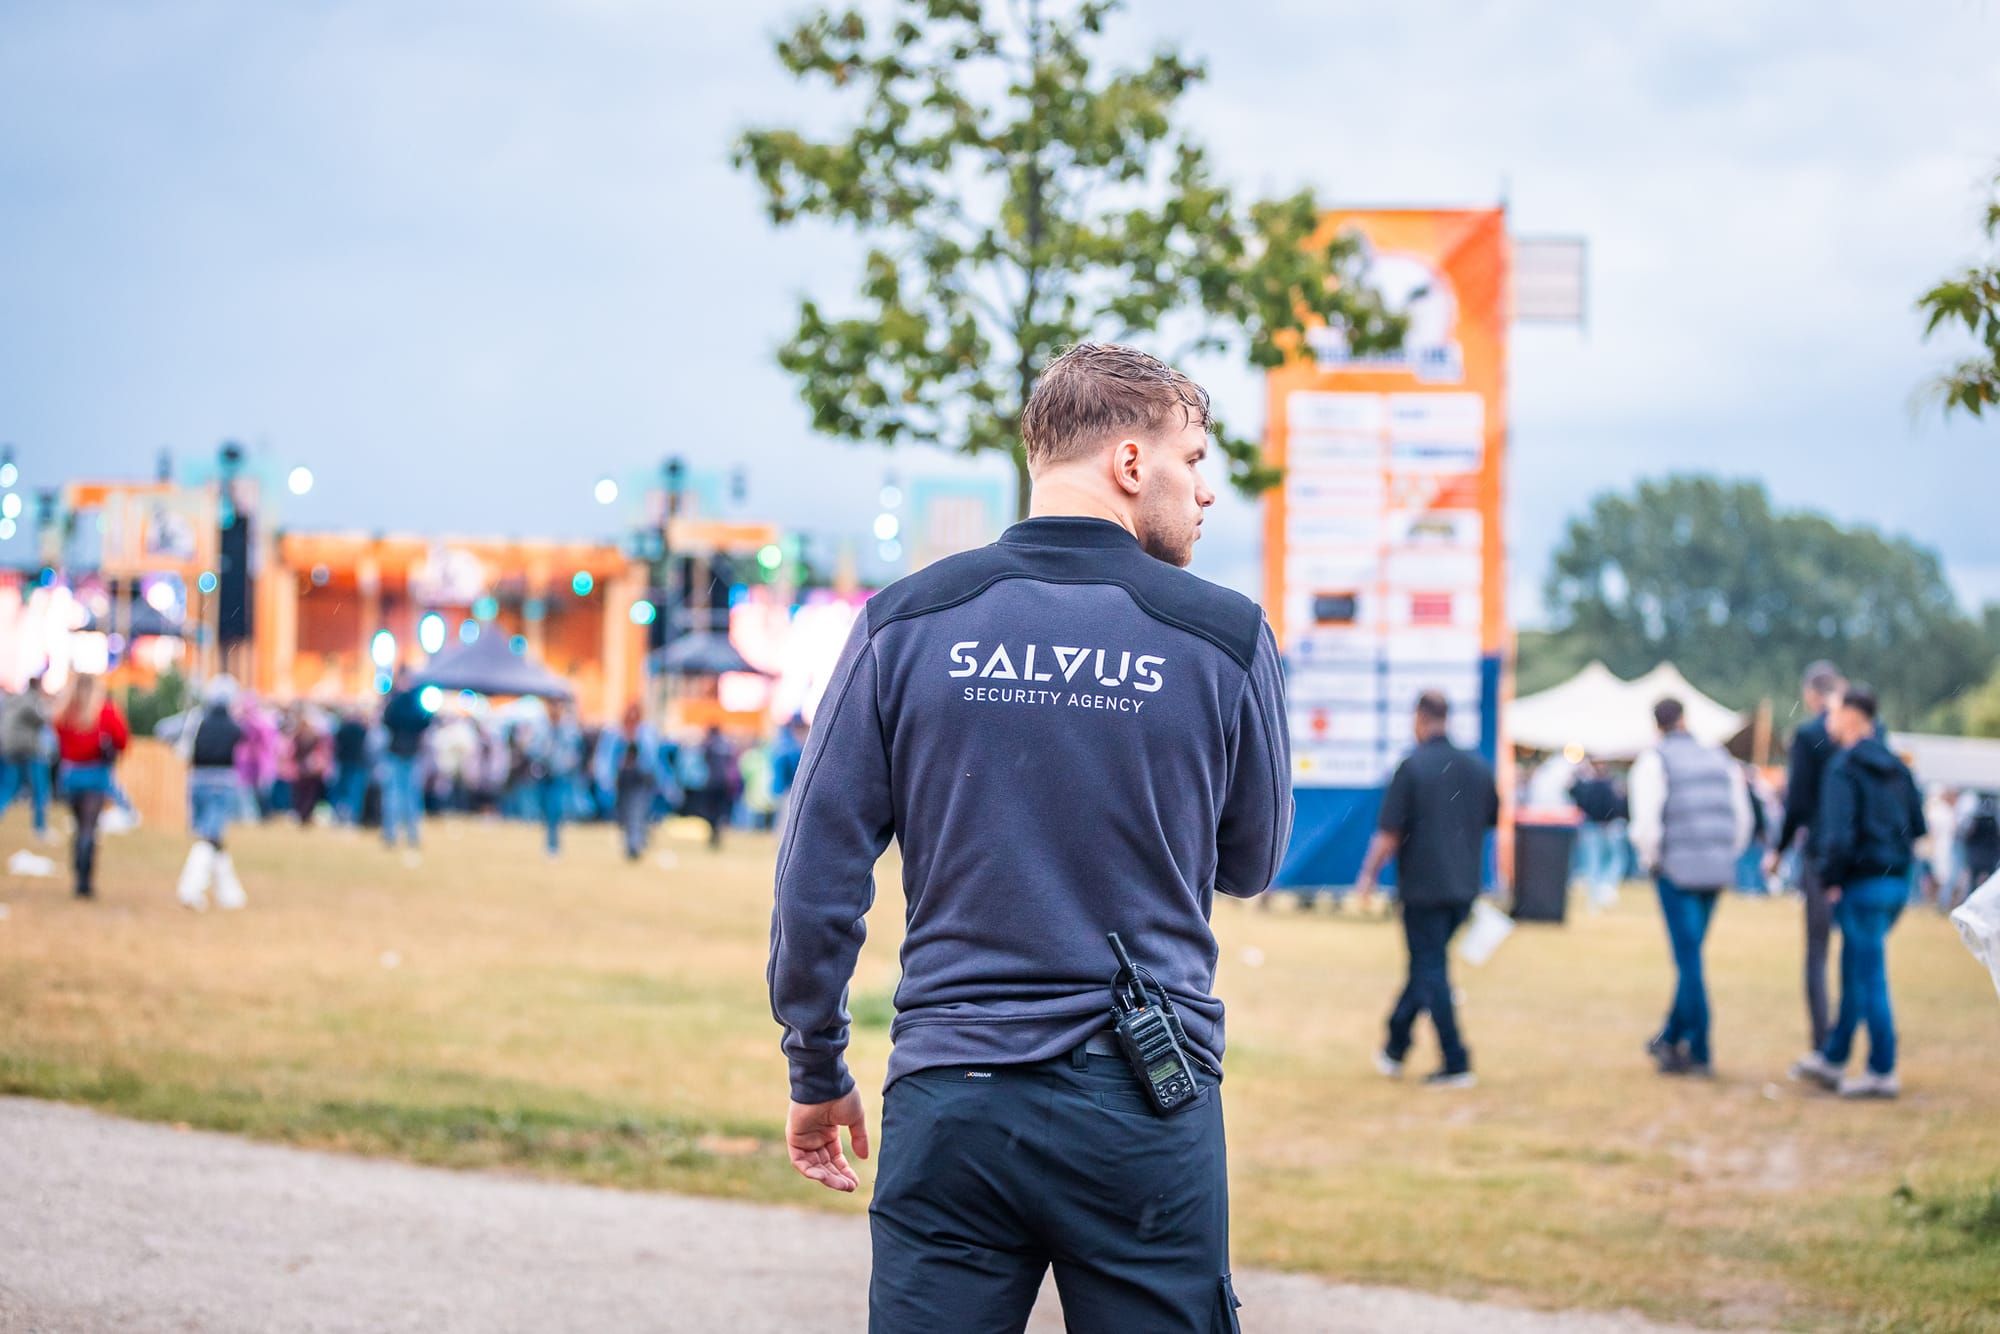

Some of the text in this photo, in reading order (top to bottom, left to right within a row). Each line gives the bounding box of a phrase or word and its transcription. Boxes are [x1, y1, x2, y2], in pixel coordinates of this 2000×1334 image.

[948, 641, 1167, 693] SALVUS
[963, 687, 1145, 714] SECURITY AGENCY
